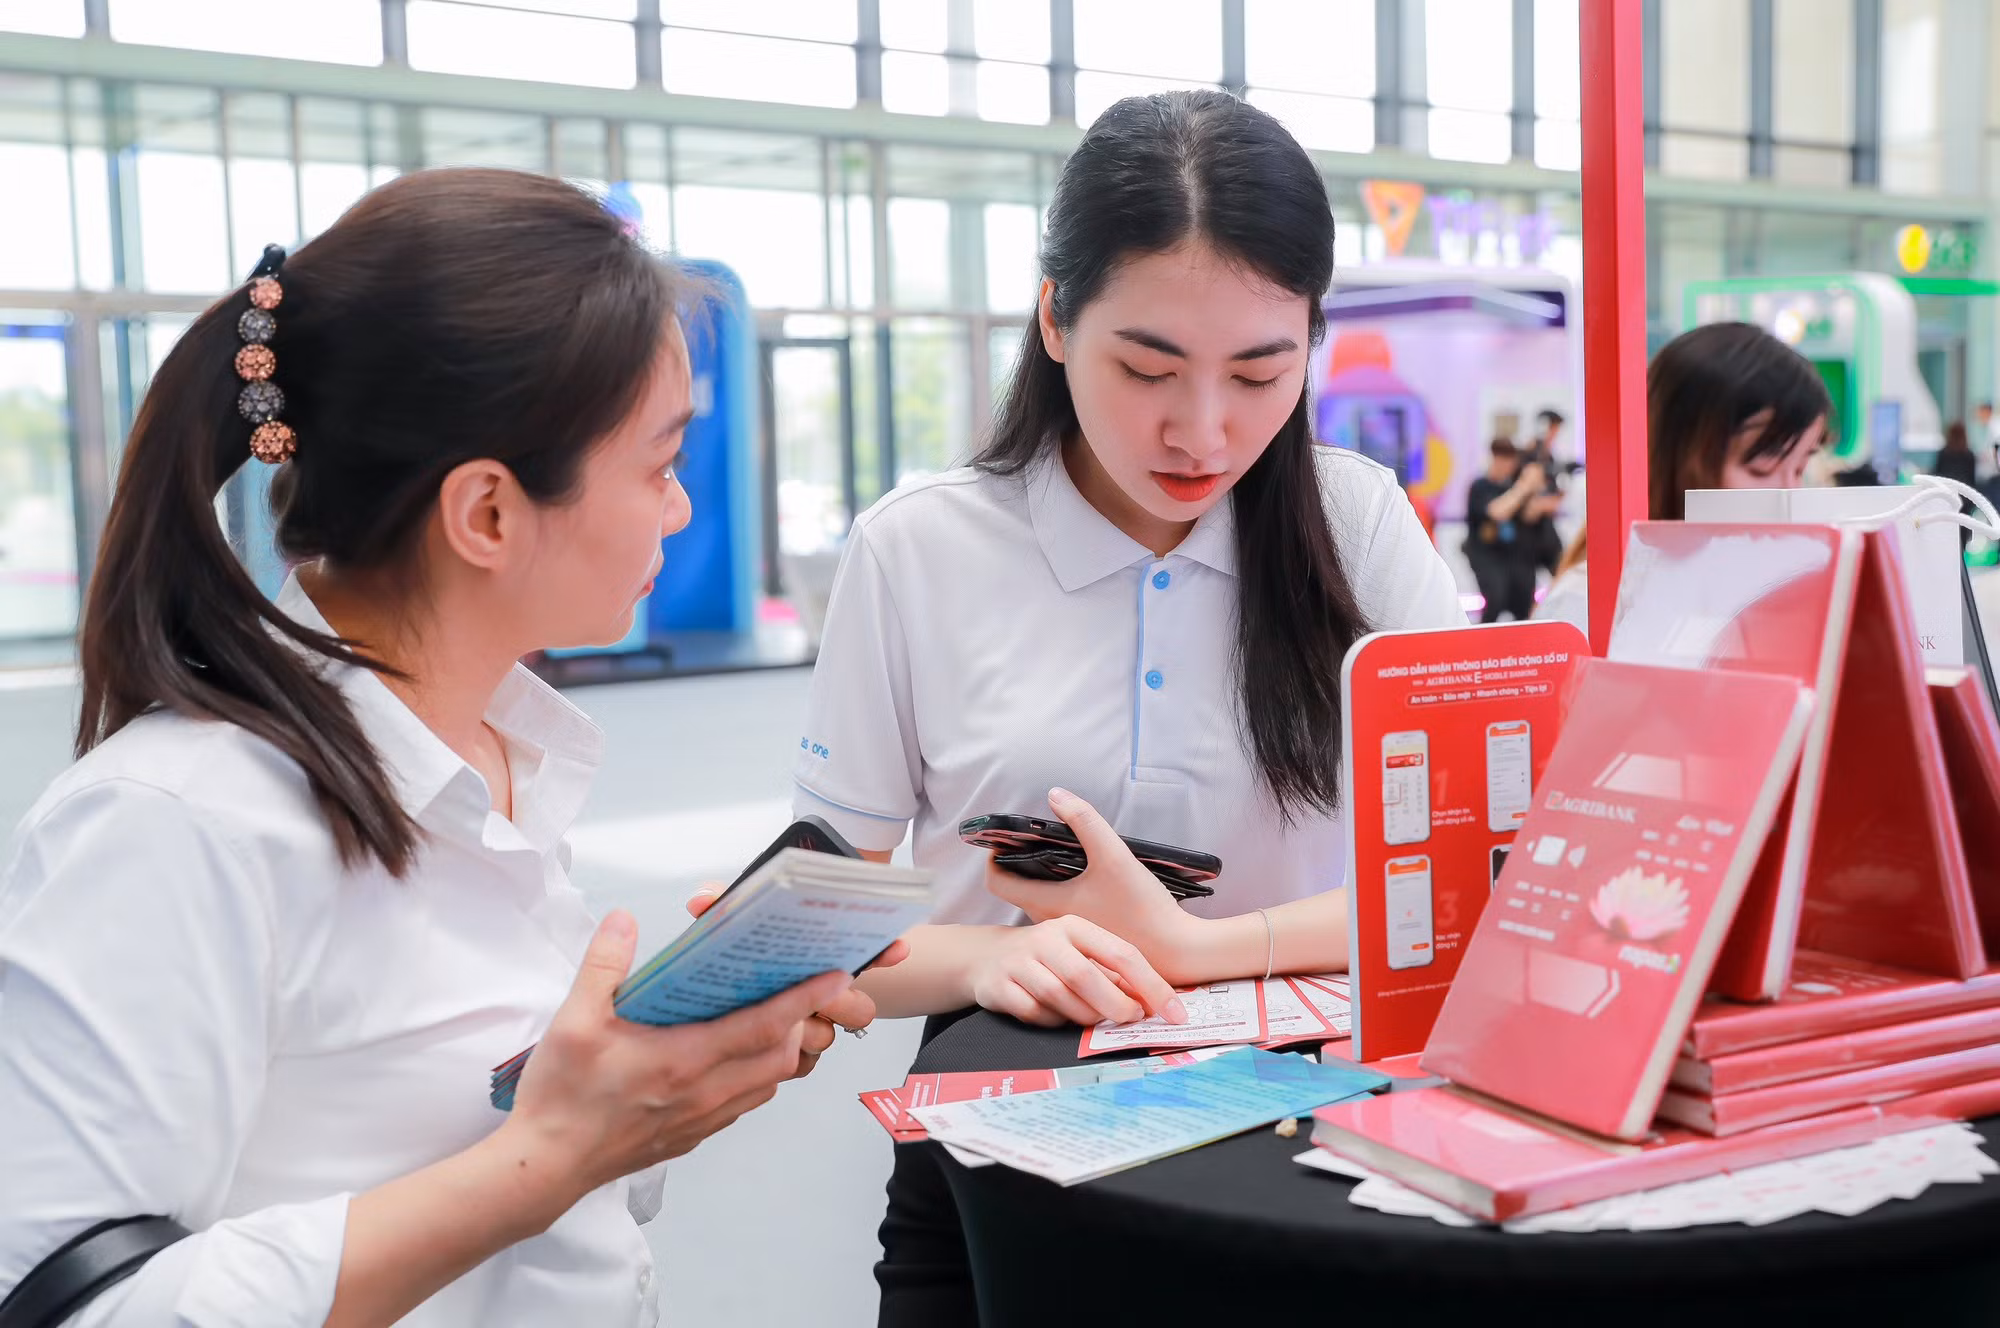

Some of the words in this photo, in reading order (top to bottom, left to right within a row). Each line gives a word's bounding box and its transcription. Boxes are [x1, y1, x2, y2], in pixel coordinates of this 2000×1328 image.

[1453, 659, 1480, 672] THÔNG
[1482, 658, 1499, 669] BÁO
[1544, 652, 1556, 664] SỐ
[1426, 674, 1473, 687] AGRIBANK
[812, 743, 829, 759] one
[1563, 797, 1636, 824] AGRIBANK
